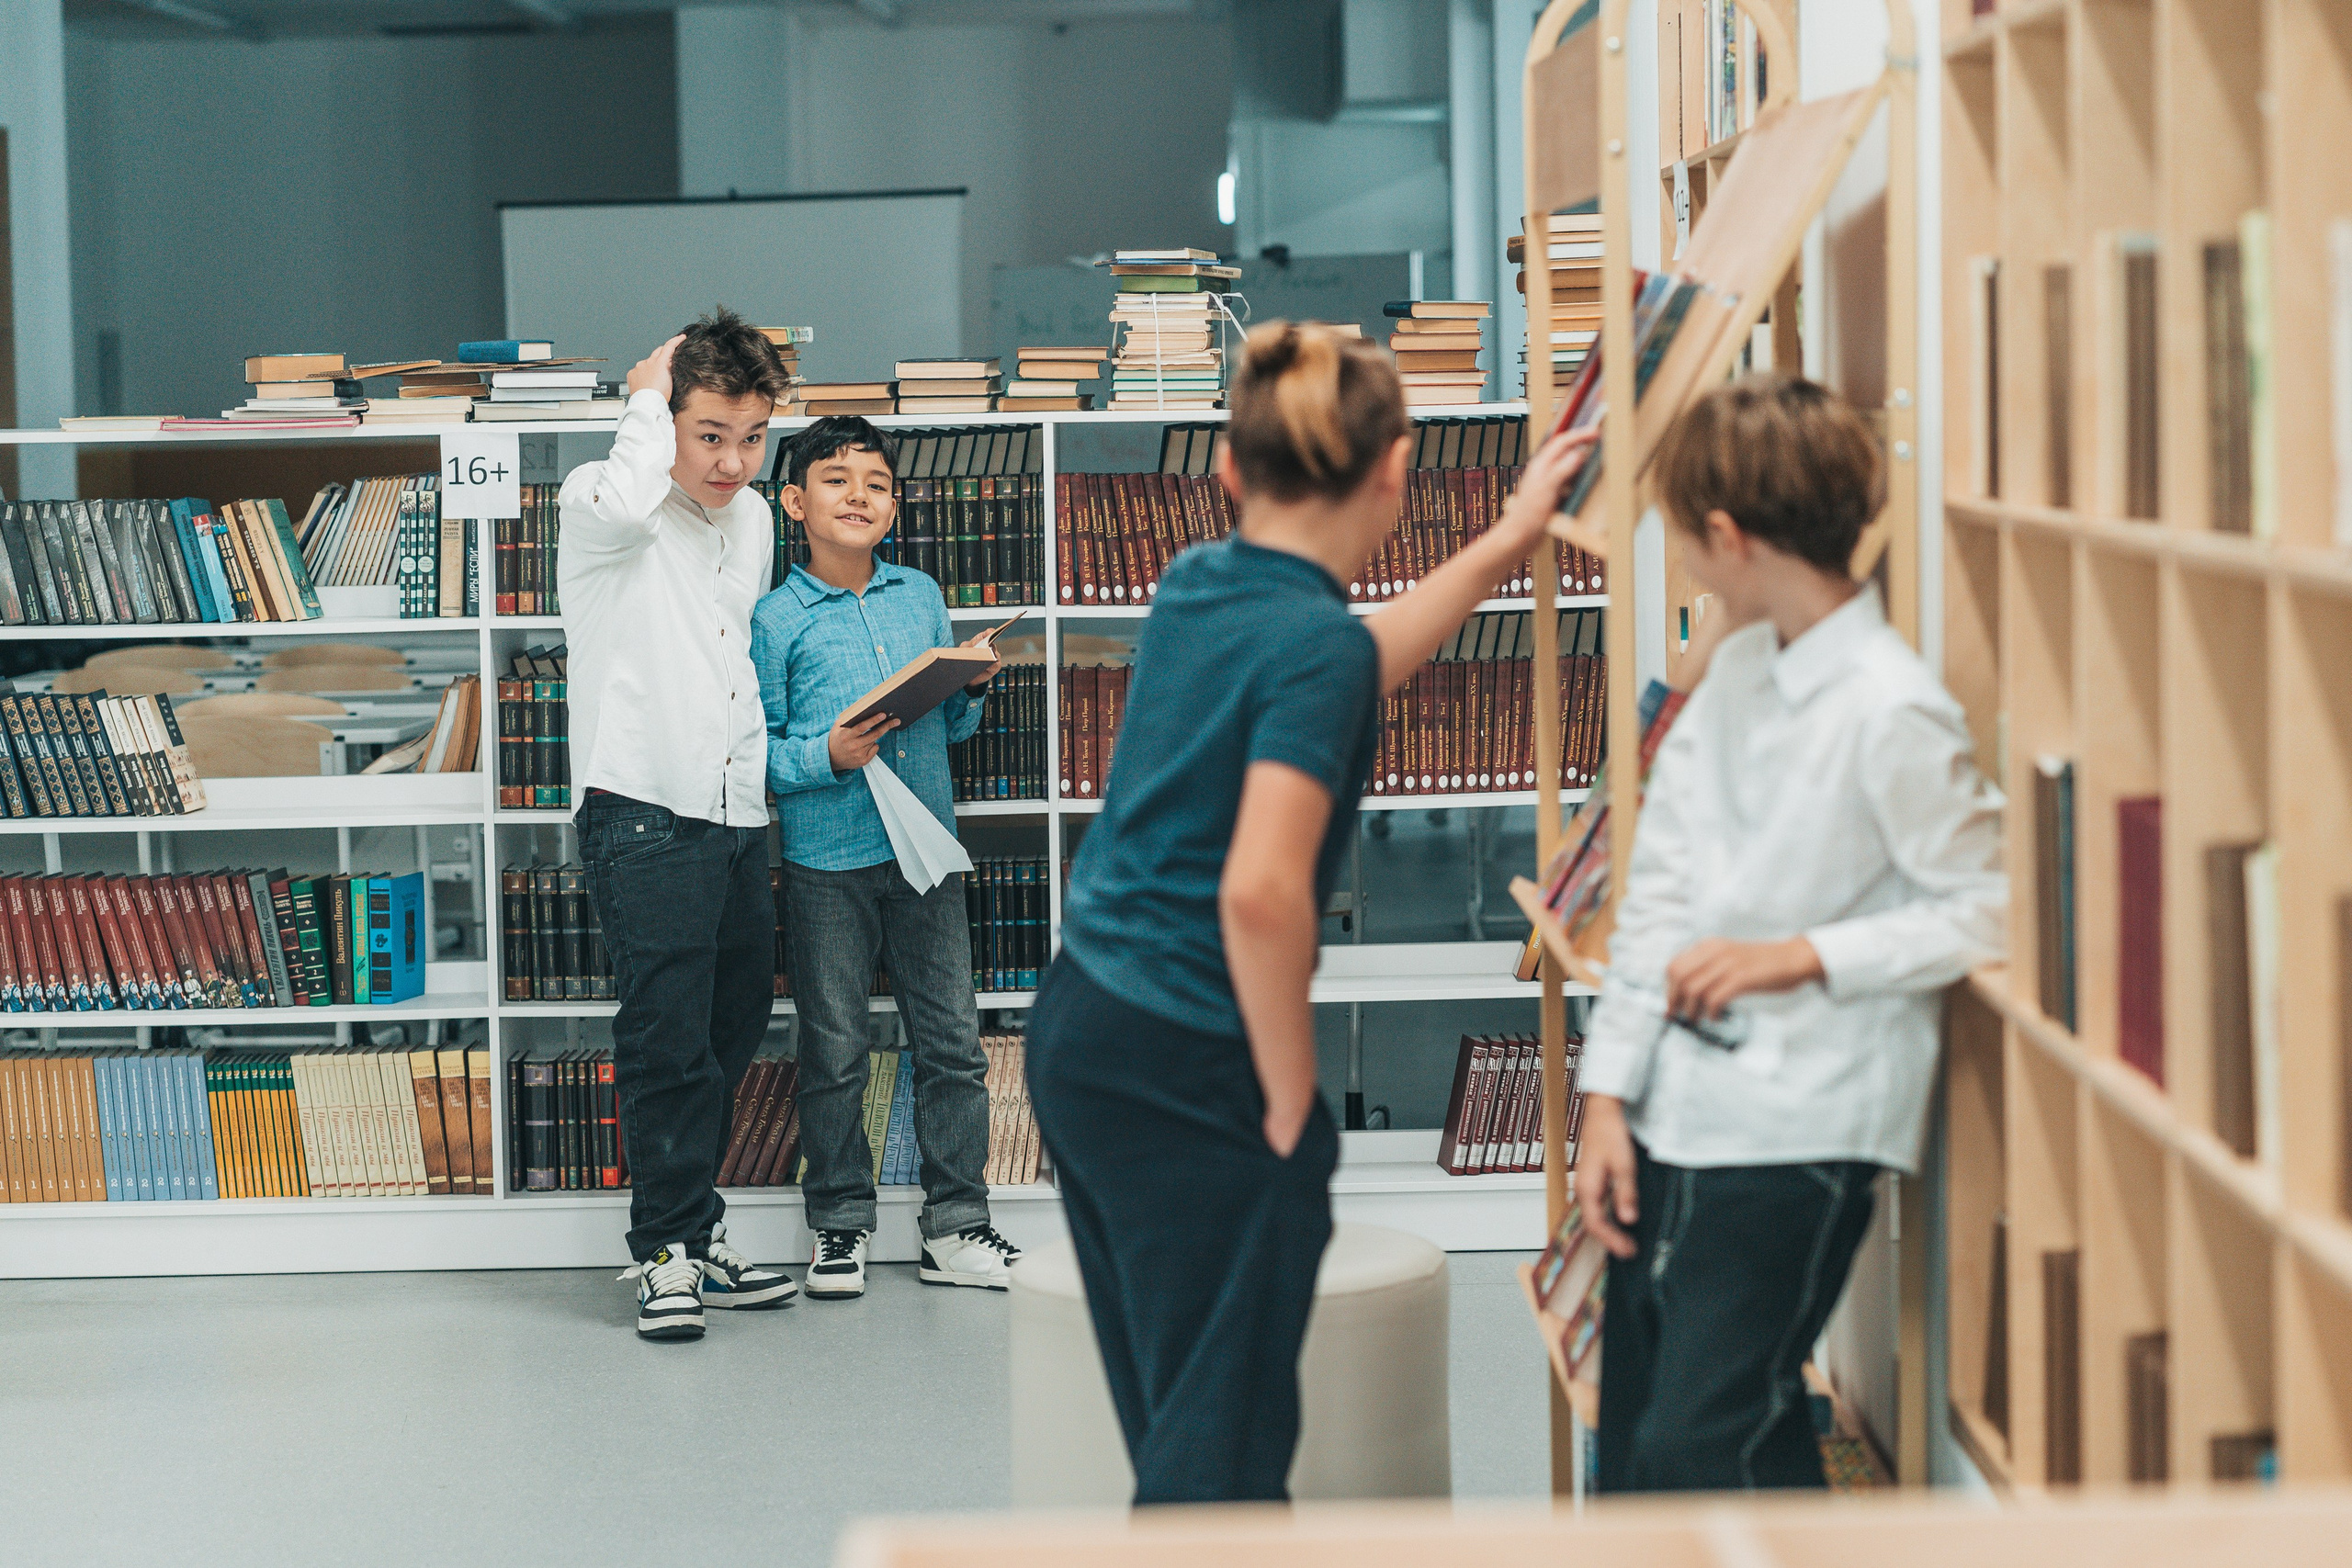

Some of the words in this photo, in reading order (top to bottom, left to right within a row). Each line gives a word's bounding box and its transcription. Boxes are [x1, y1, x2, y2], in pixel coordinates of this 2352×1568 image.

[447, 456, 509, 485] 16+
[1118, 485, 1126, 510] Маргарита
[1222, 513, 1230, 532] Фрегат
[469, 578, 478, 602] МИРЫ
[333, 889, 344, 920] Пикуль
[335, 922, 346, 964] Валентин
[871, 1103, 887, 1136] ТОЛСТОЙ
[889, 1101, 904, 1136] ТОЛСТОЙ
[884, 1143, 898, 1167] ЧЕХОВ
